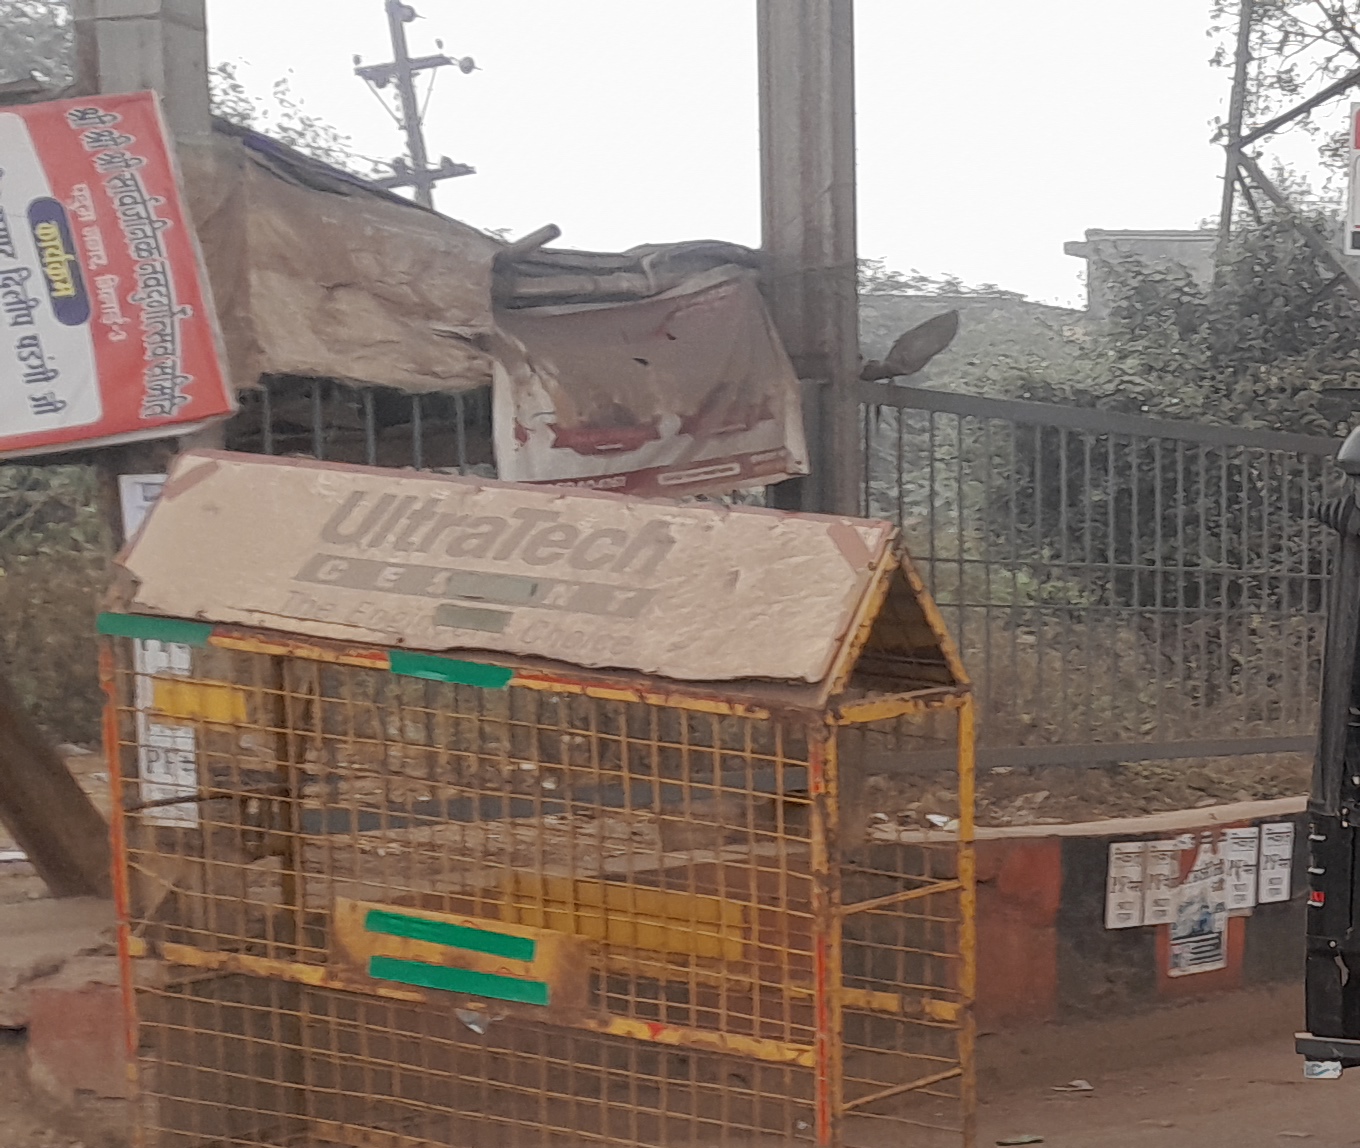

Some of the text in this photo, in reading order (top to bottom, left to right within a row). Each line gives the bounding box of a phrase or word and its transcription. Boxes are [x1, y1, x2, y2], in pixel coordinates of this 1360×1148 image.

[67, 107, 121, 129] श्री
[83, 128, 135, 150] श्री
[94, 151, 146, 173] श्री
[321, 490, 677, 576] UltraTech
[317, 559, 636, 612] CENT
